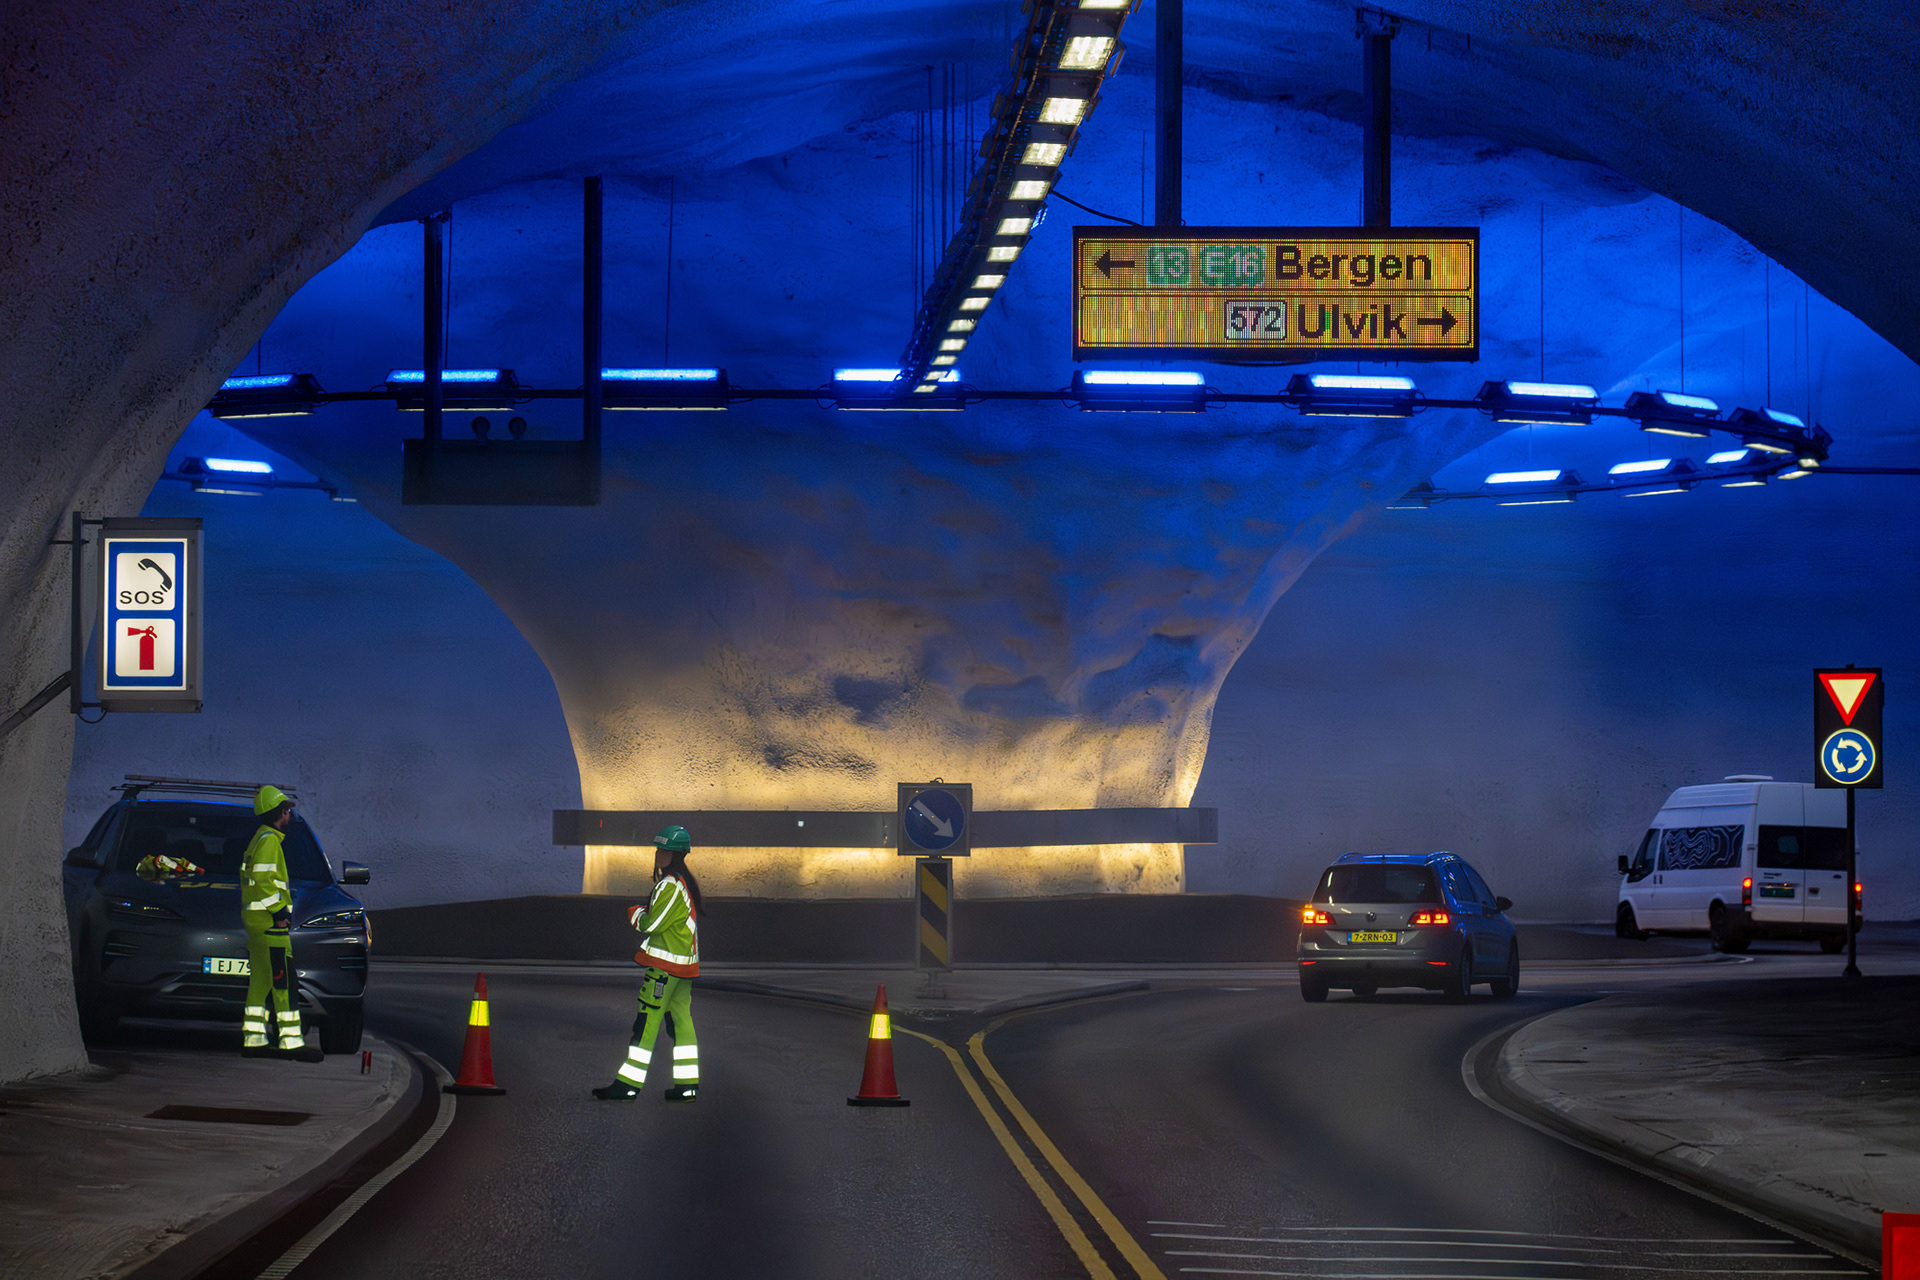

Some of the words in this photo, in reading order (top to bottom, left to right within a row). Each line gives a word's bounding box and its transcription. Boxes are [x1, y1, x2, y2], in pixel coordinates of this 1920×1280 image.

[1151, 250, 1186, 278] 13
[1203, 246, 1260, 278] E16
[1275, 245, 1432, 287] Bergen
[1230, 306, 1282, 333] 572
[1298, 304, 1407, 339] Ulvik
[119, 590, 165, 605] SOS
[218, 960, 232, 973] EJ
